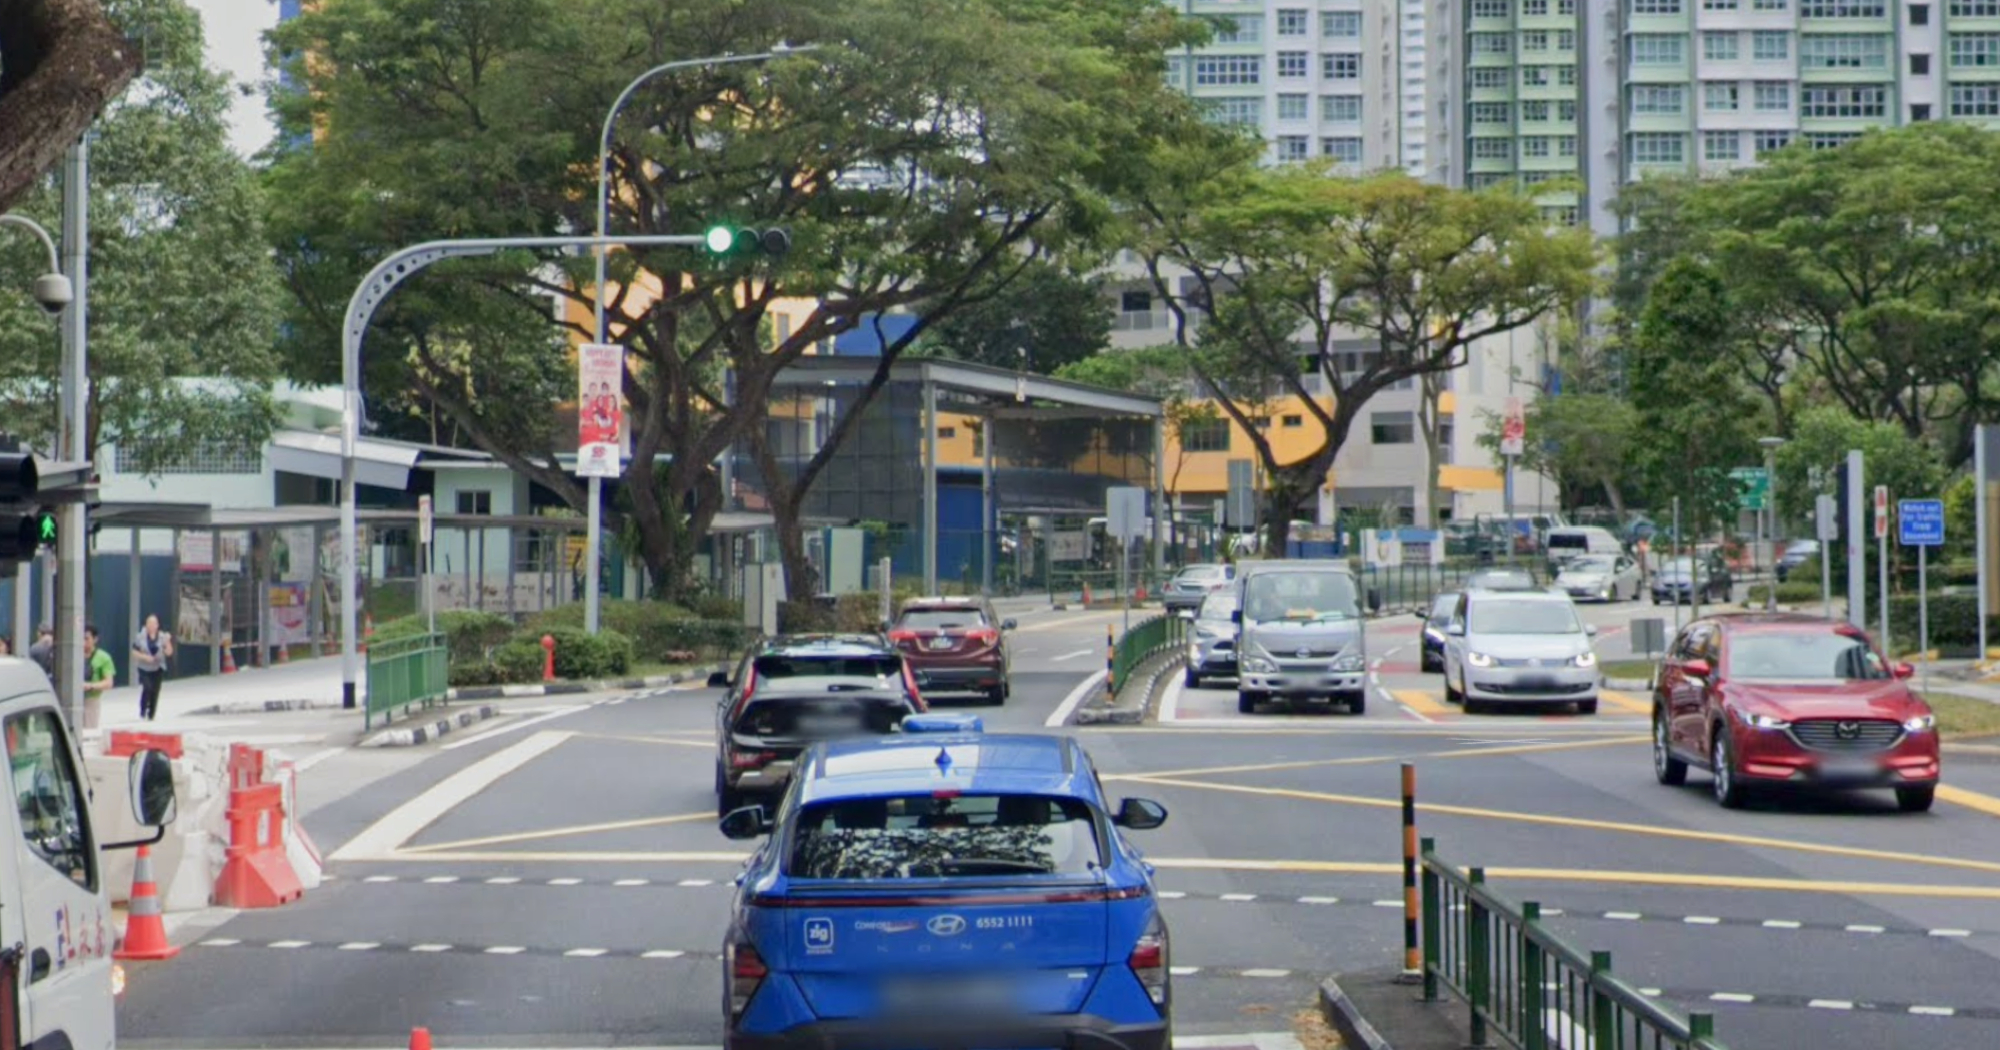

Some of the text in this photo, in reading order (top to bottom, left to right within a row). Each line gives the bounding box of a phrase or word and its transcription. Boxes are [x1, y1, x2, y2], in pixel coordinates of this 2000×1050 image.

[976, 916, 1033, 928] 6552 1111
[809, 923, 829, 942] zig
